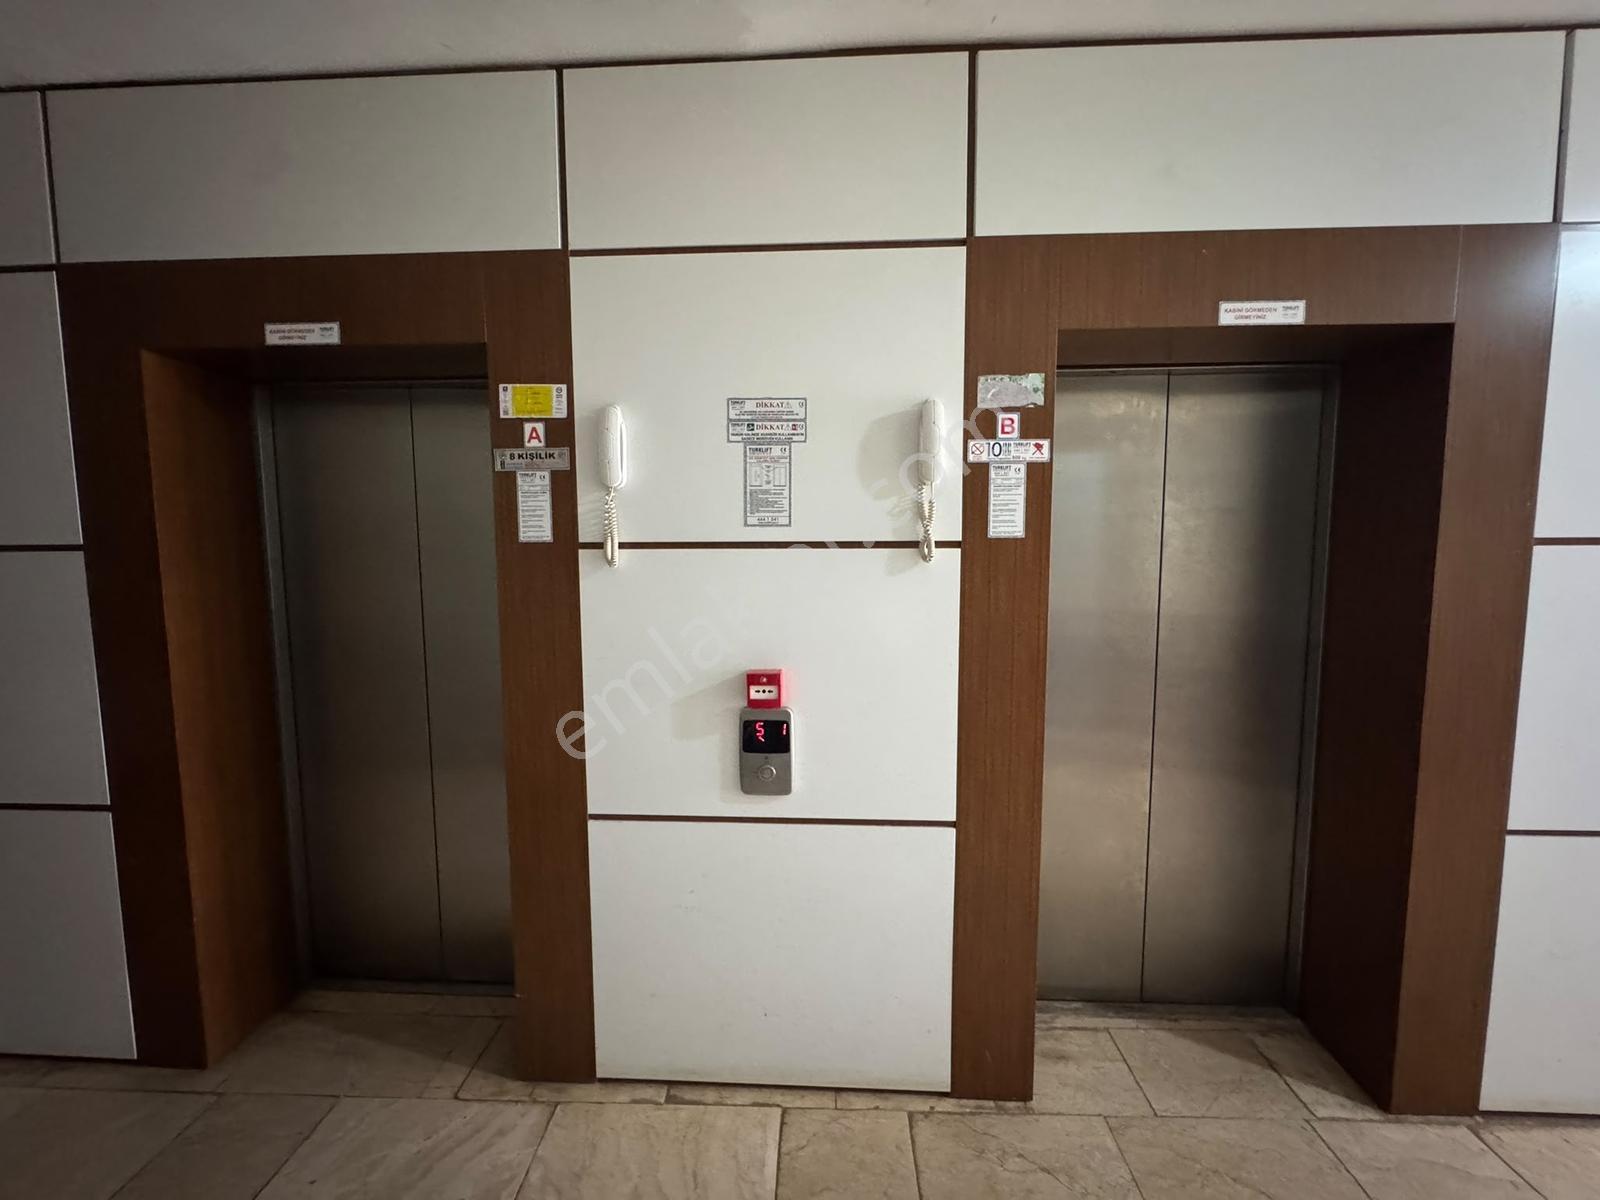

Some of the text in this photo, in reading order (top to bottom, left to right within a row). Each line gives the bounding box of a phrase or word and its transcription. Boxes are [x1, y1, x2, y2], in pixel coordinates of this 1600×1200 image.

[755, 423, 784, 431] DİKKAT
[1001, 417, 1015, 435] B
[527, 426, 542, 443] A
[509, 451, 556, 461] 8 KİŞİLİK
[985, 441, 1002, 457] 10
